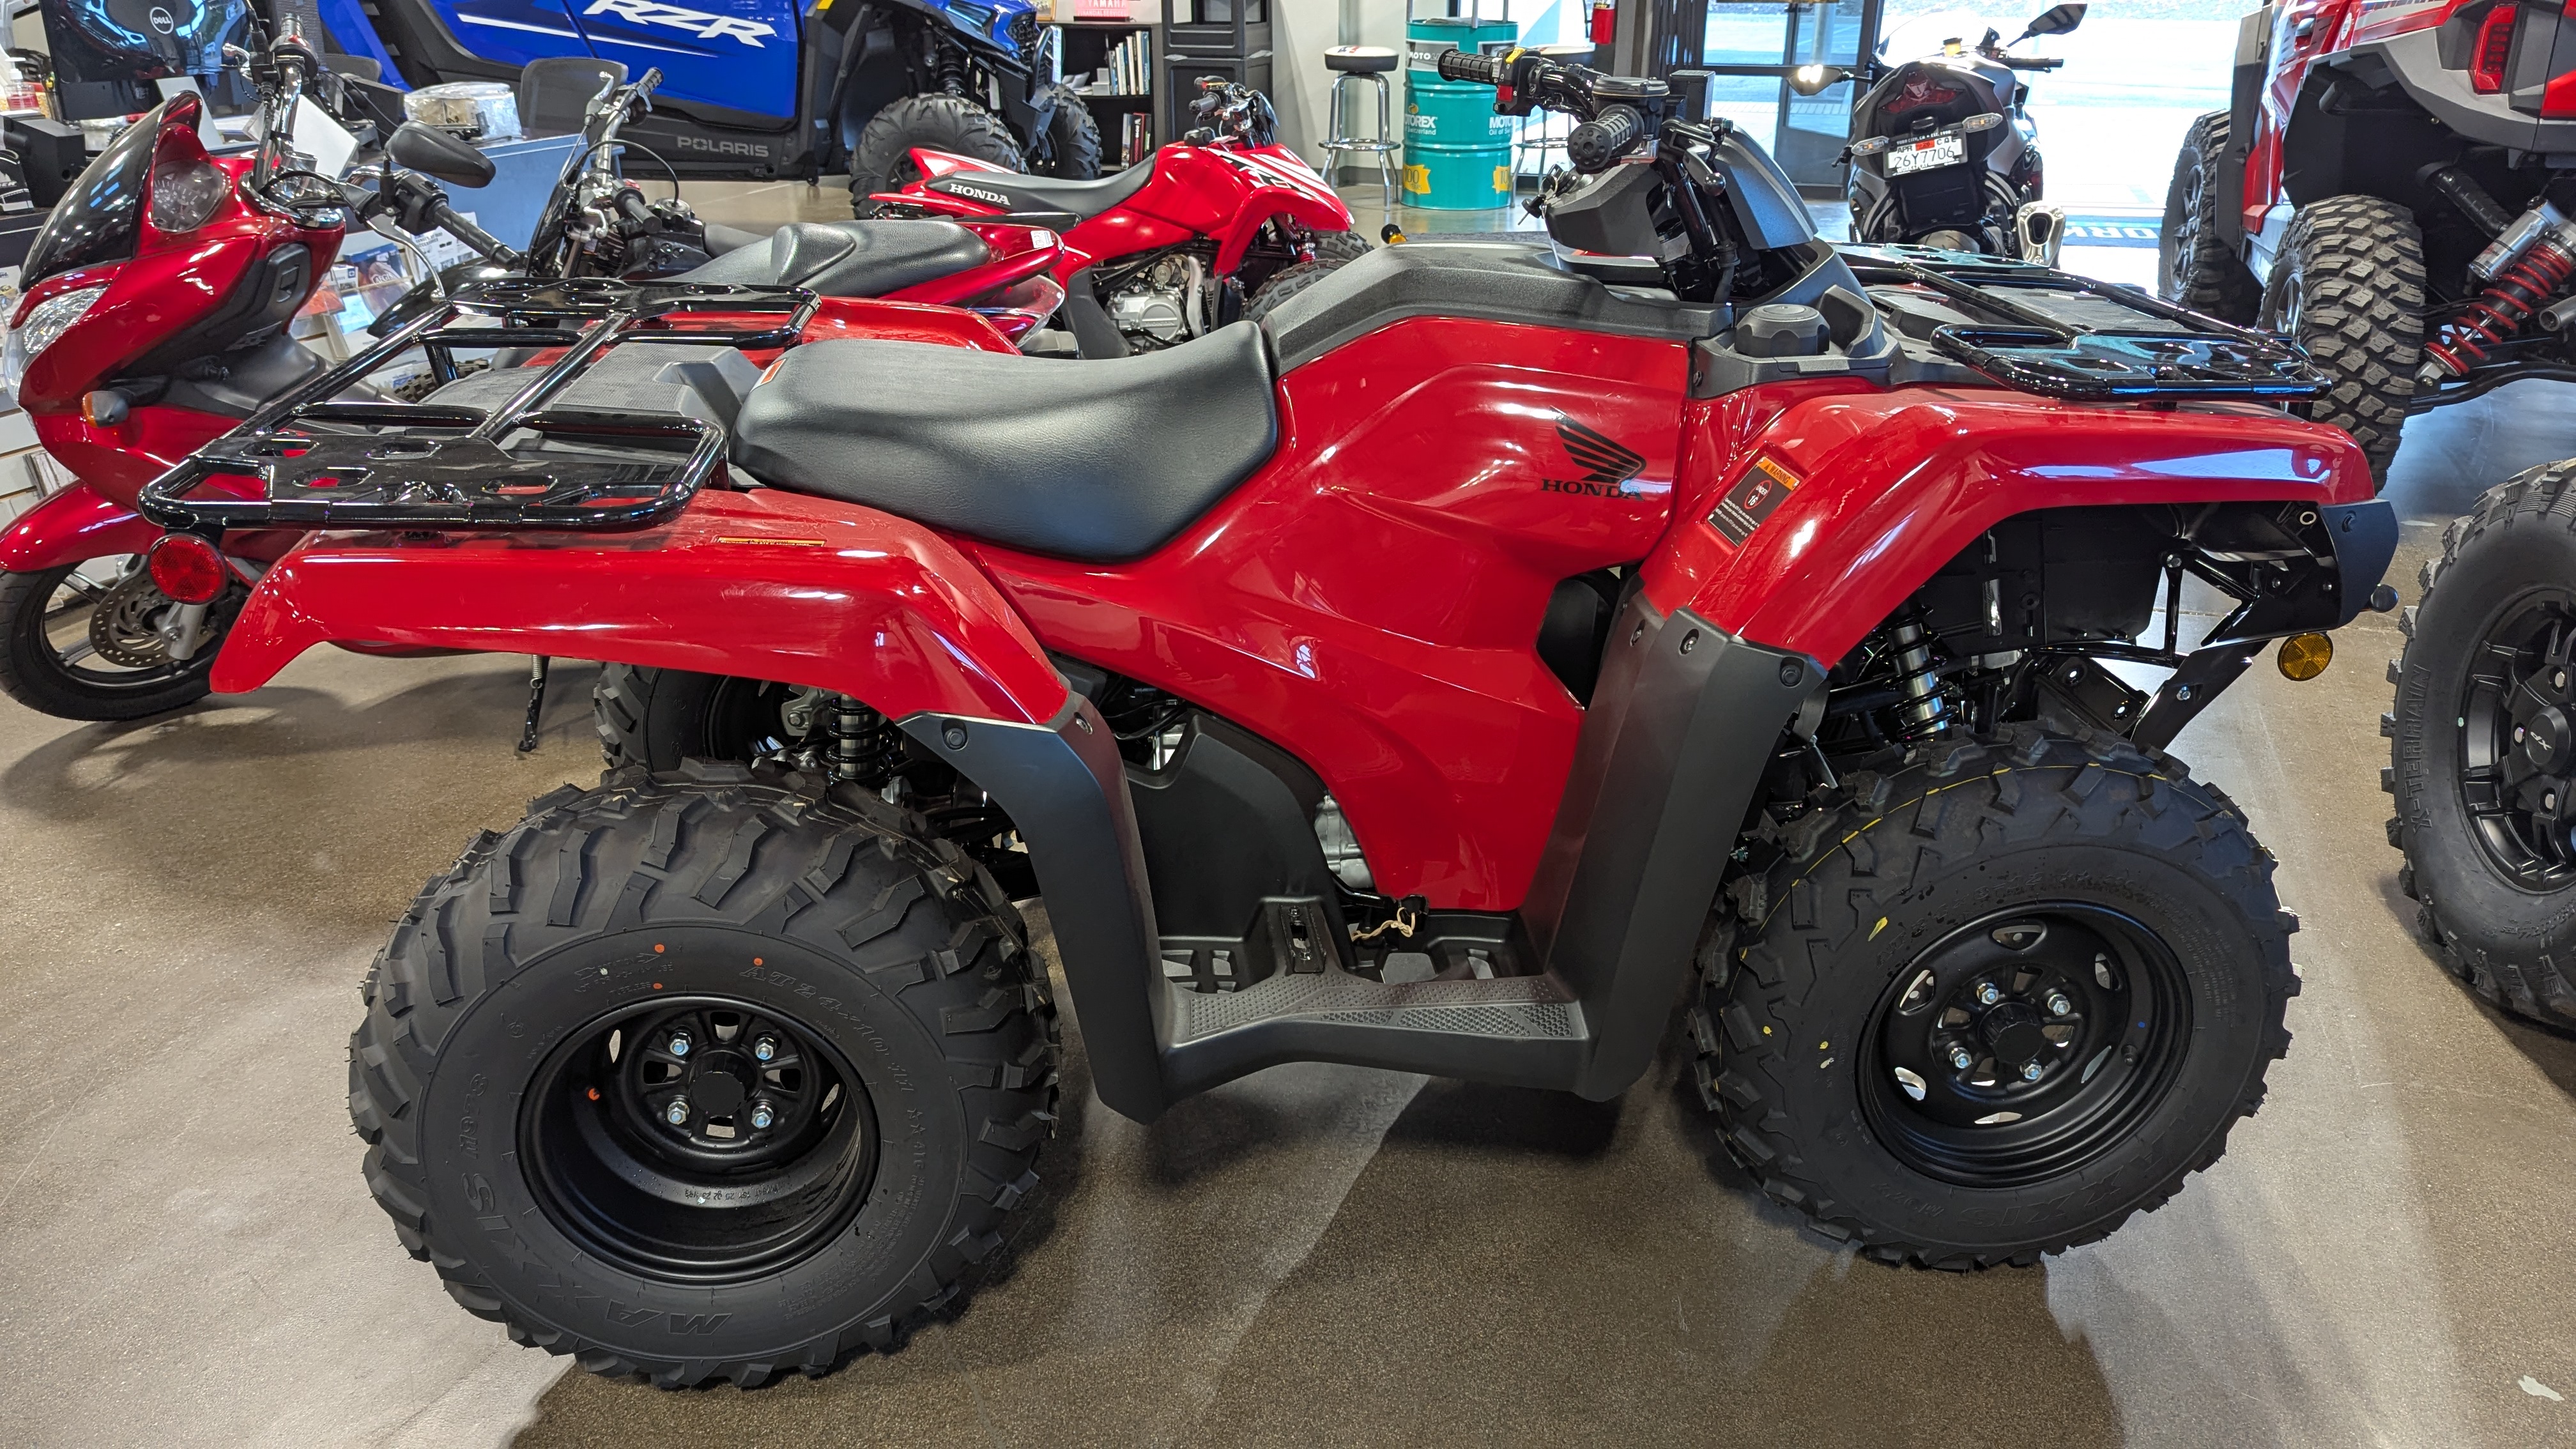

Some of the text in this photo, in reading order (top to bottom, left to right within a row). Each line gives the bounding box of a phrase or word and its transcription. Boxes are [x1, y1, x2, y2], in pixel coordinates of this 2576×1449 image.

[582, 0, 777, 48] RZR
[1405, 114, 1438, 128] OTOREX
[677, 136, 769, 158] POLARIS
[1894, 146, 1955, 169] 26Y7706
[1897, 145, 1913, 153] APR
[949, 183, 1011, 206] HONDA
[2062, 226, 2159, 239] ORK
[1768, 464, 1791, 484] WARNING
[1540, 479, 1646, 502] HONDA
[1747, 494, 1759, 506] 16
[1756, 484, 1769, 496] UNDER
[2400, 664, 2432, 836] X-TERRAIN
[2530, 730, 2553, 751] XP
[461, 1172, 733, 1336] MAXXIS
